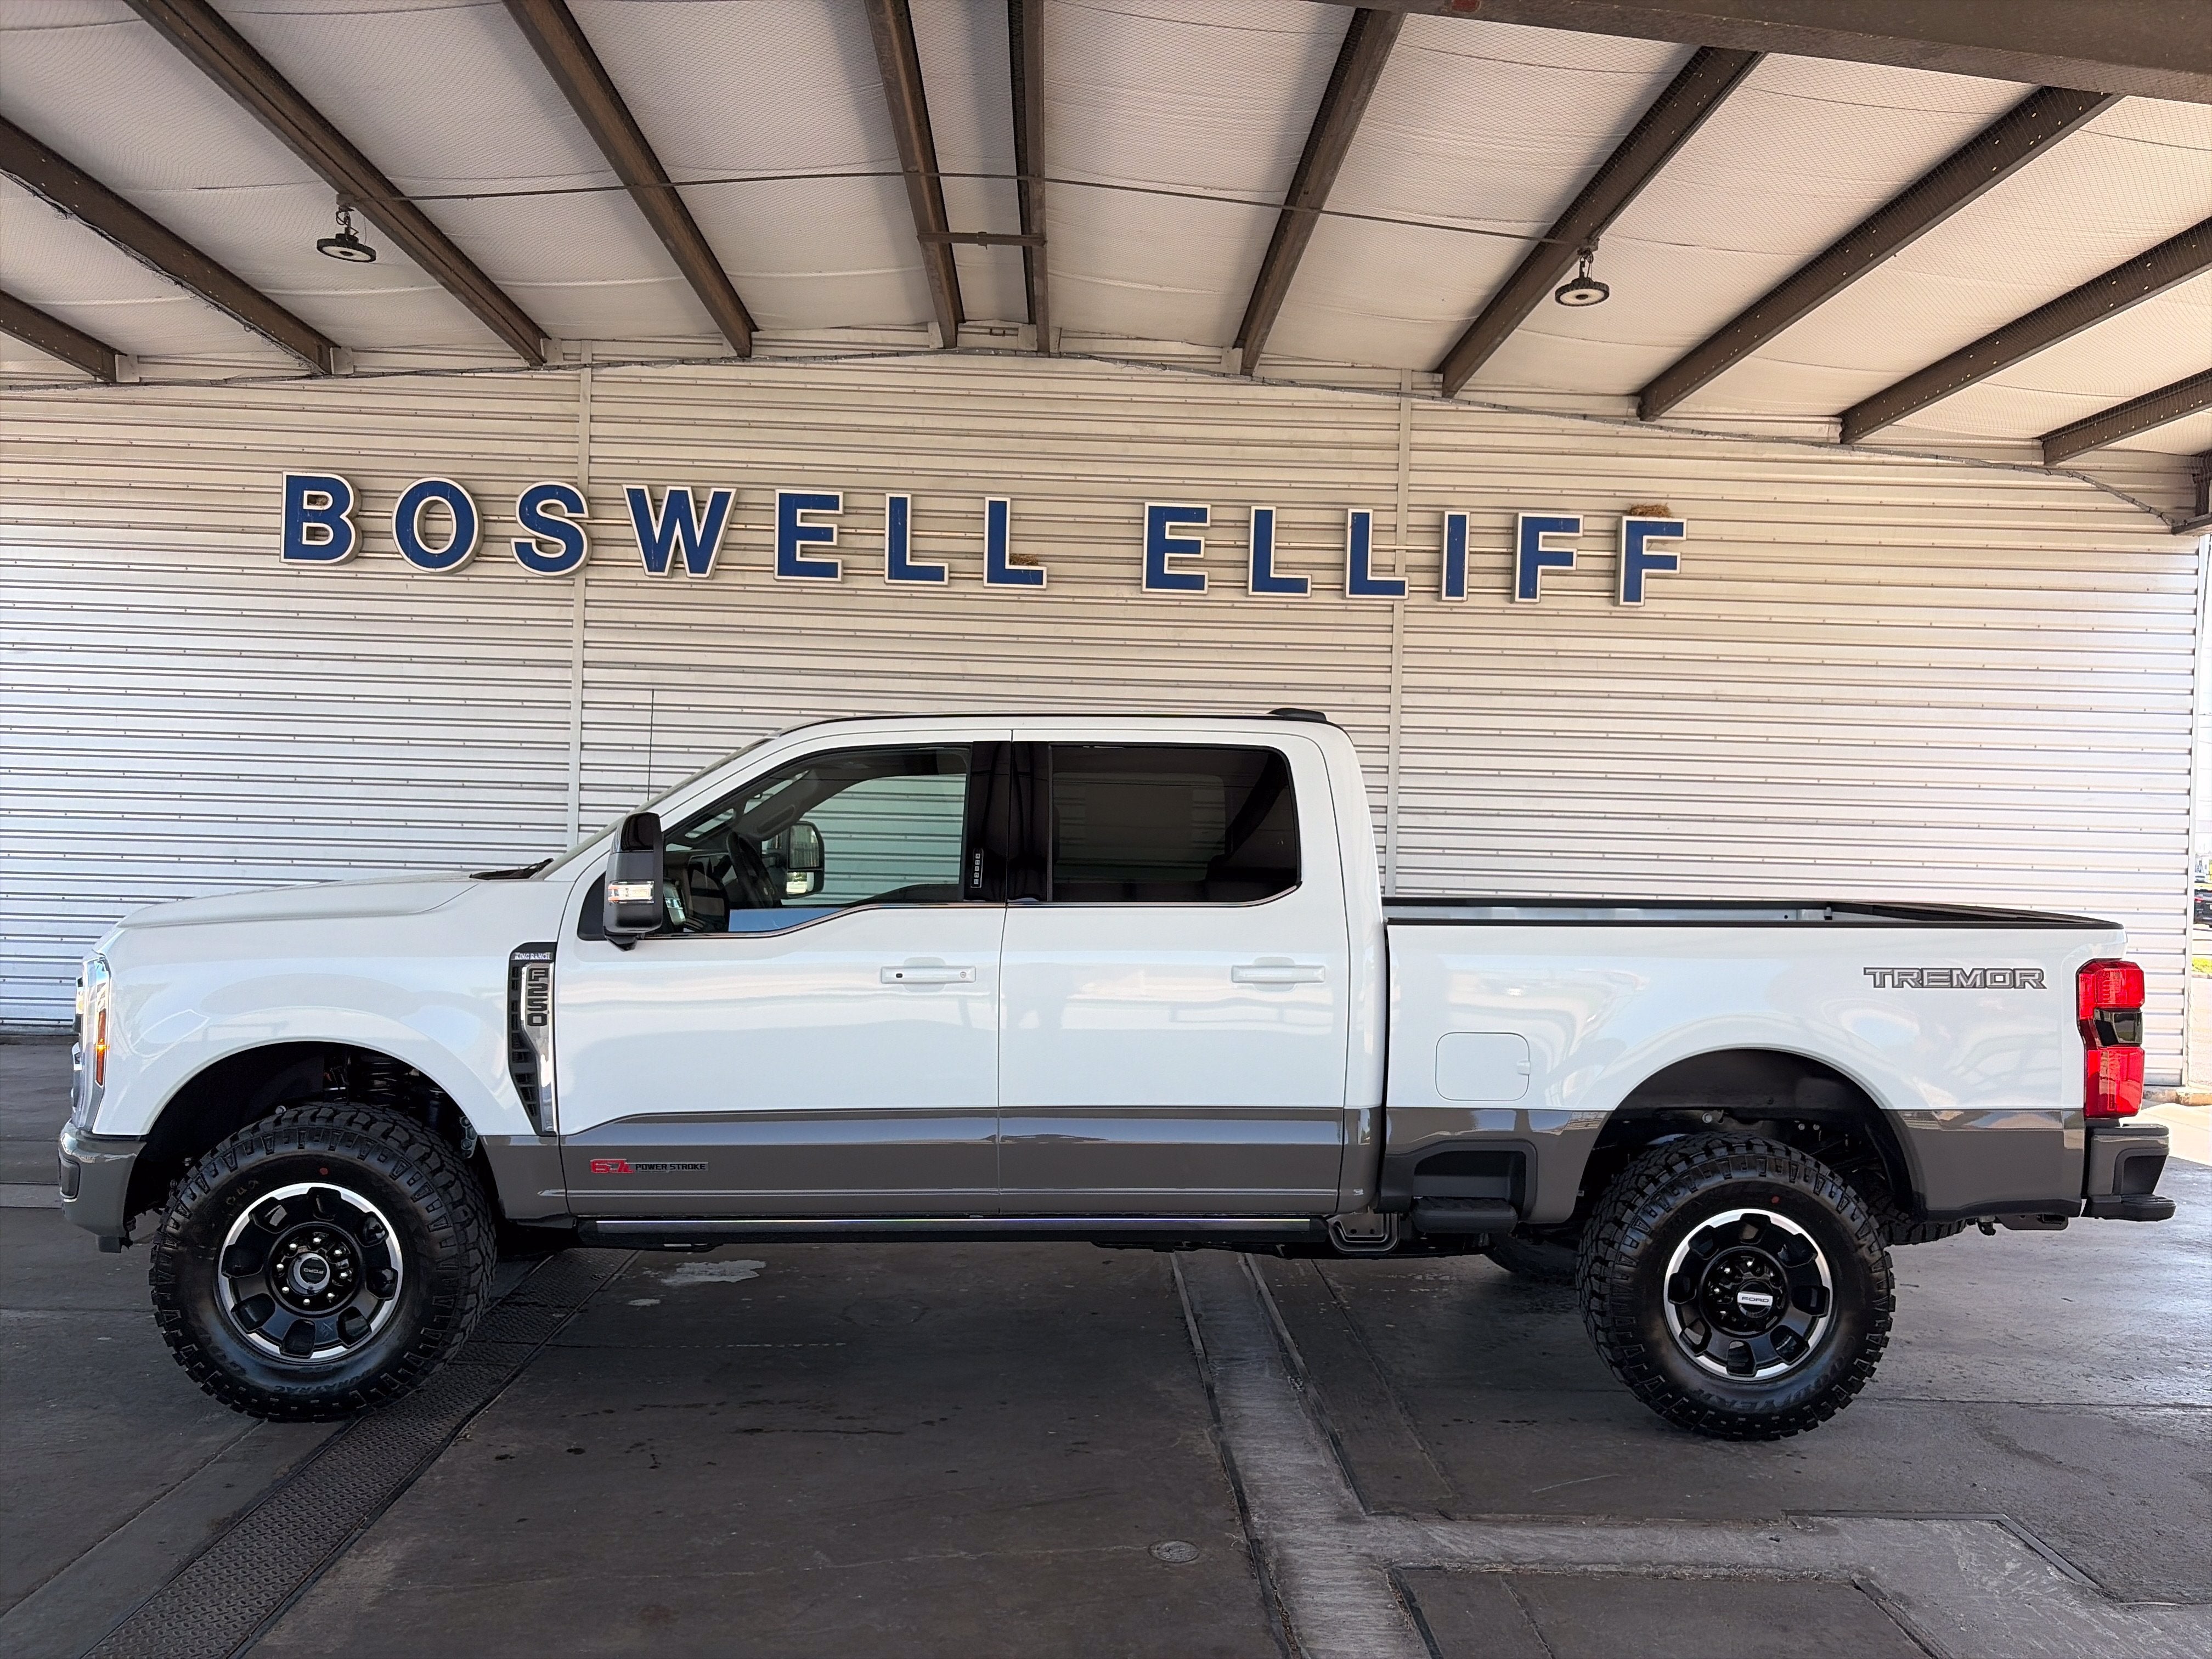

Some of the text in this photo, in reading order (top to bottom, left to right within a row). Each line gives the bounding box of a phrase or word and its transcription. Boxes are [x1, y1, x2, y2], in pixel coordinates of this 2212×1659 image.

[279, 471, 1687, 606] BOSWELL ELLIFF
[1863, 967, 2047, 989] TREMOR
[1741, 1295, 1770, 1304] FORD
